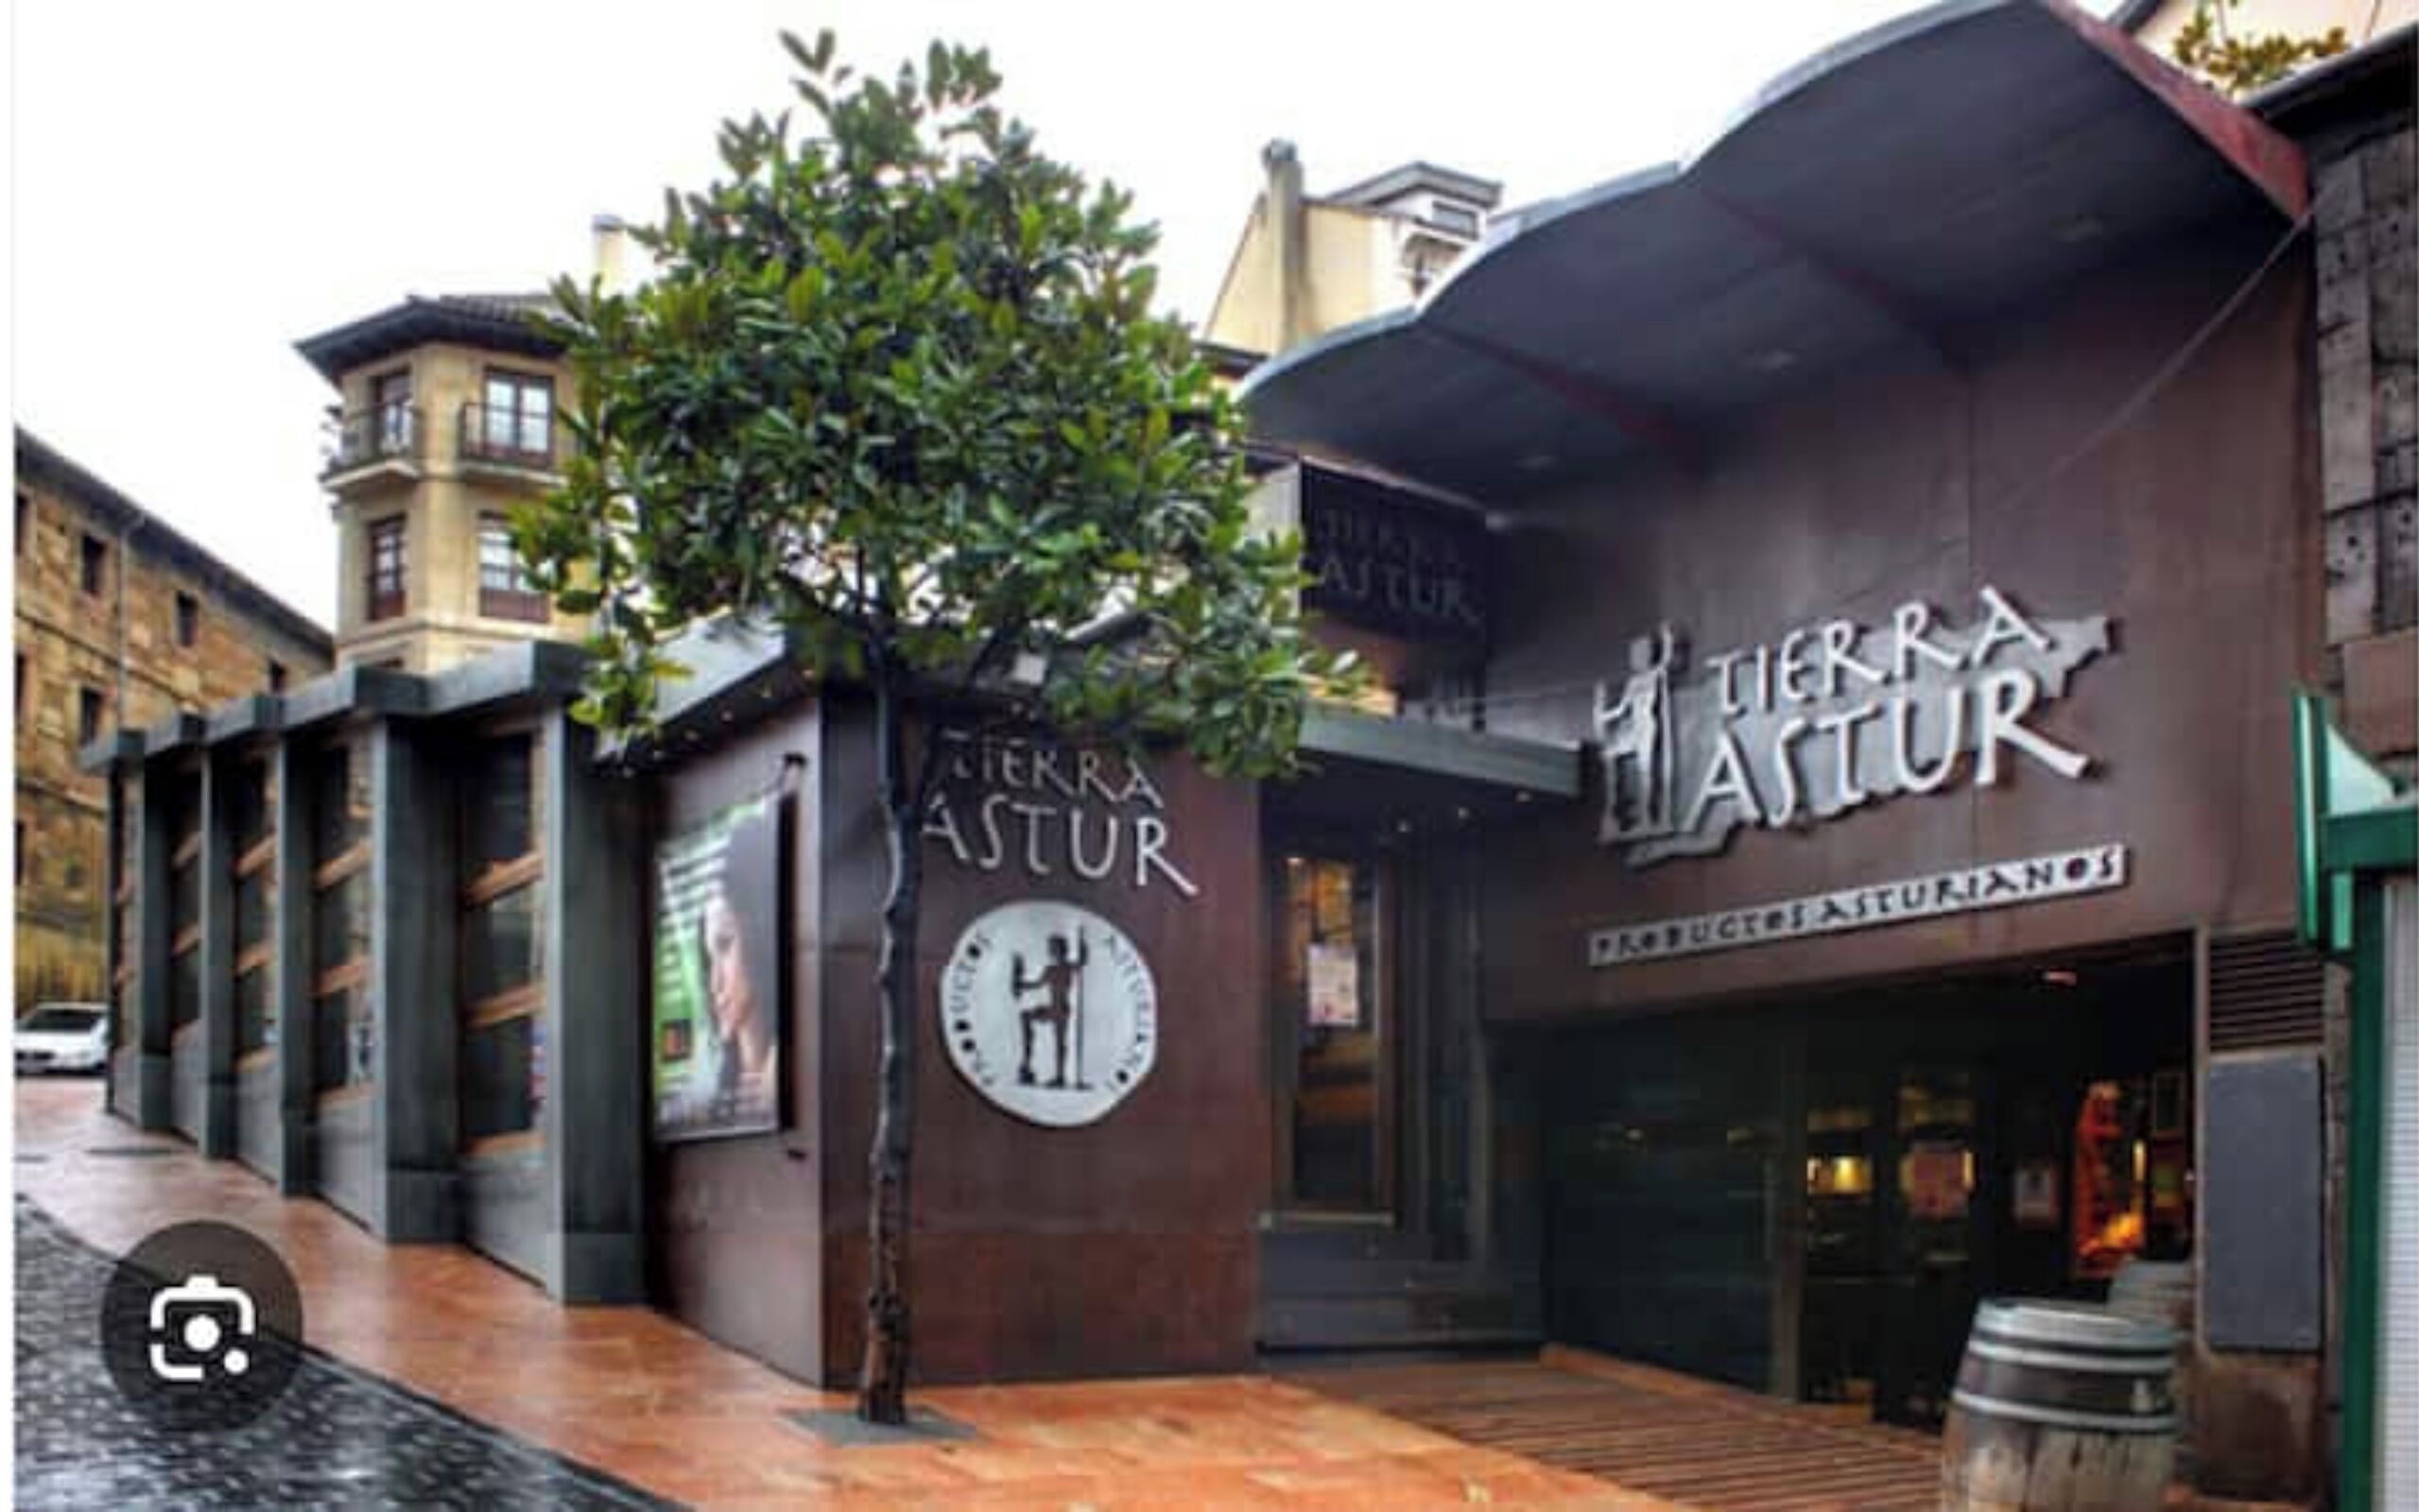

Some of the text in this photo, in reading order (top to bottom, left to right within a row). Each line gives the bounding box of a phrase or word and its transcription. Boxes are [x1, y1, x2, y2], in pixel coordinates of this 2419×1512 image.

[1705, 584, 2052, 715] TIERRA
[942, 729, 1165, 810] TIERRA
[1682, 666, 2091, 830] ASTUR
[921, 791, 1201, 897] ASTUR
[1819, 848, 2117, 926] ASTURIANOS
